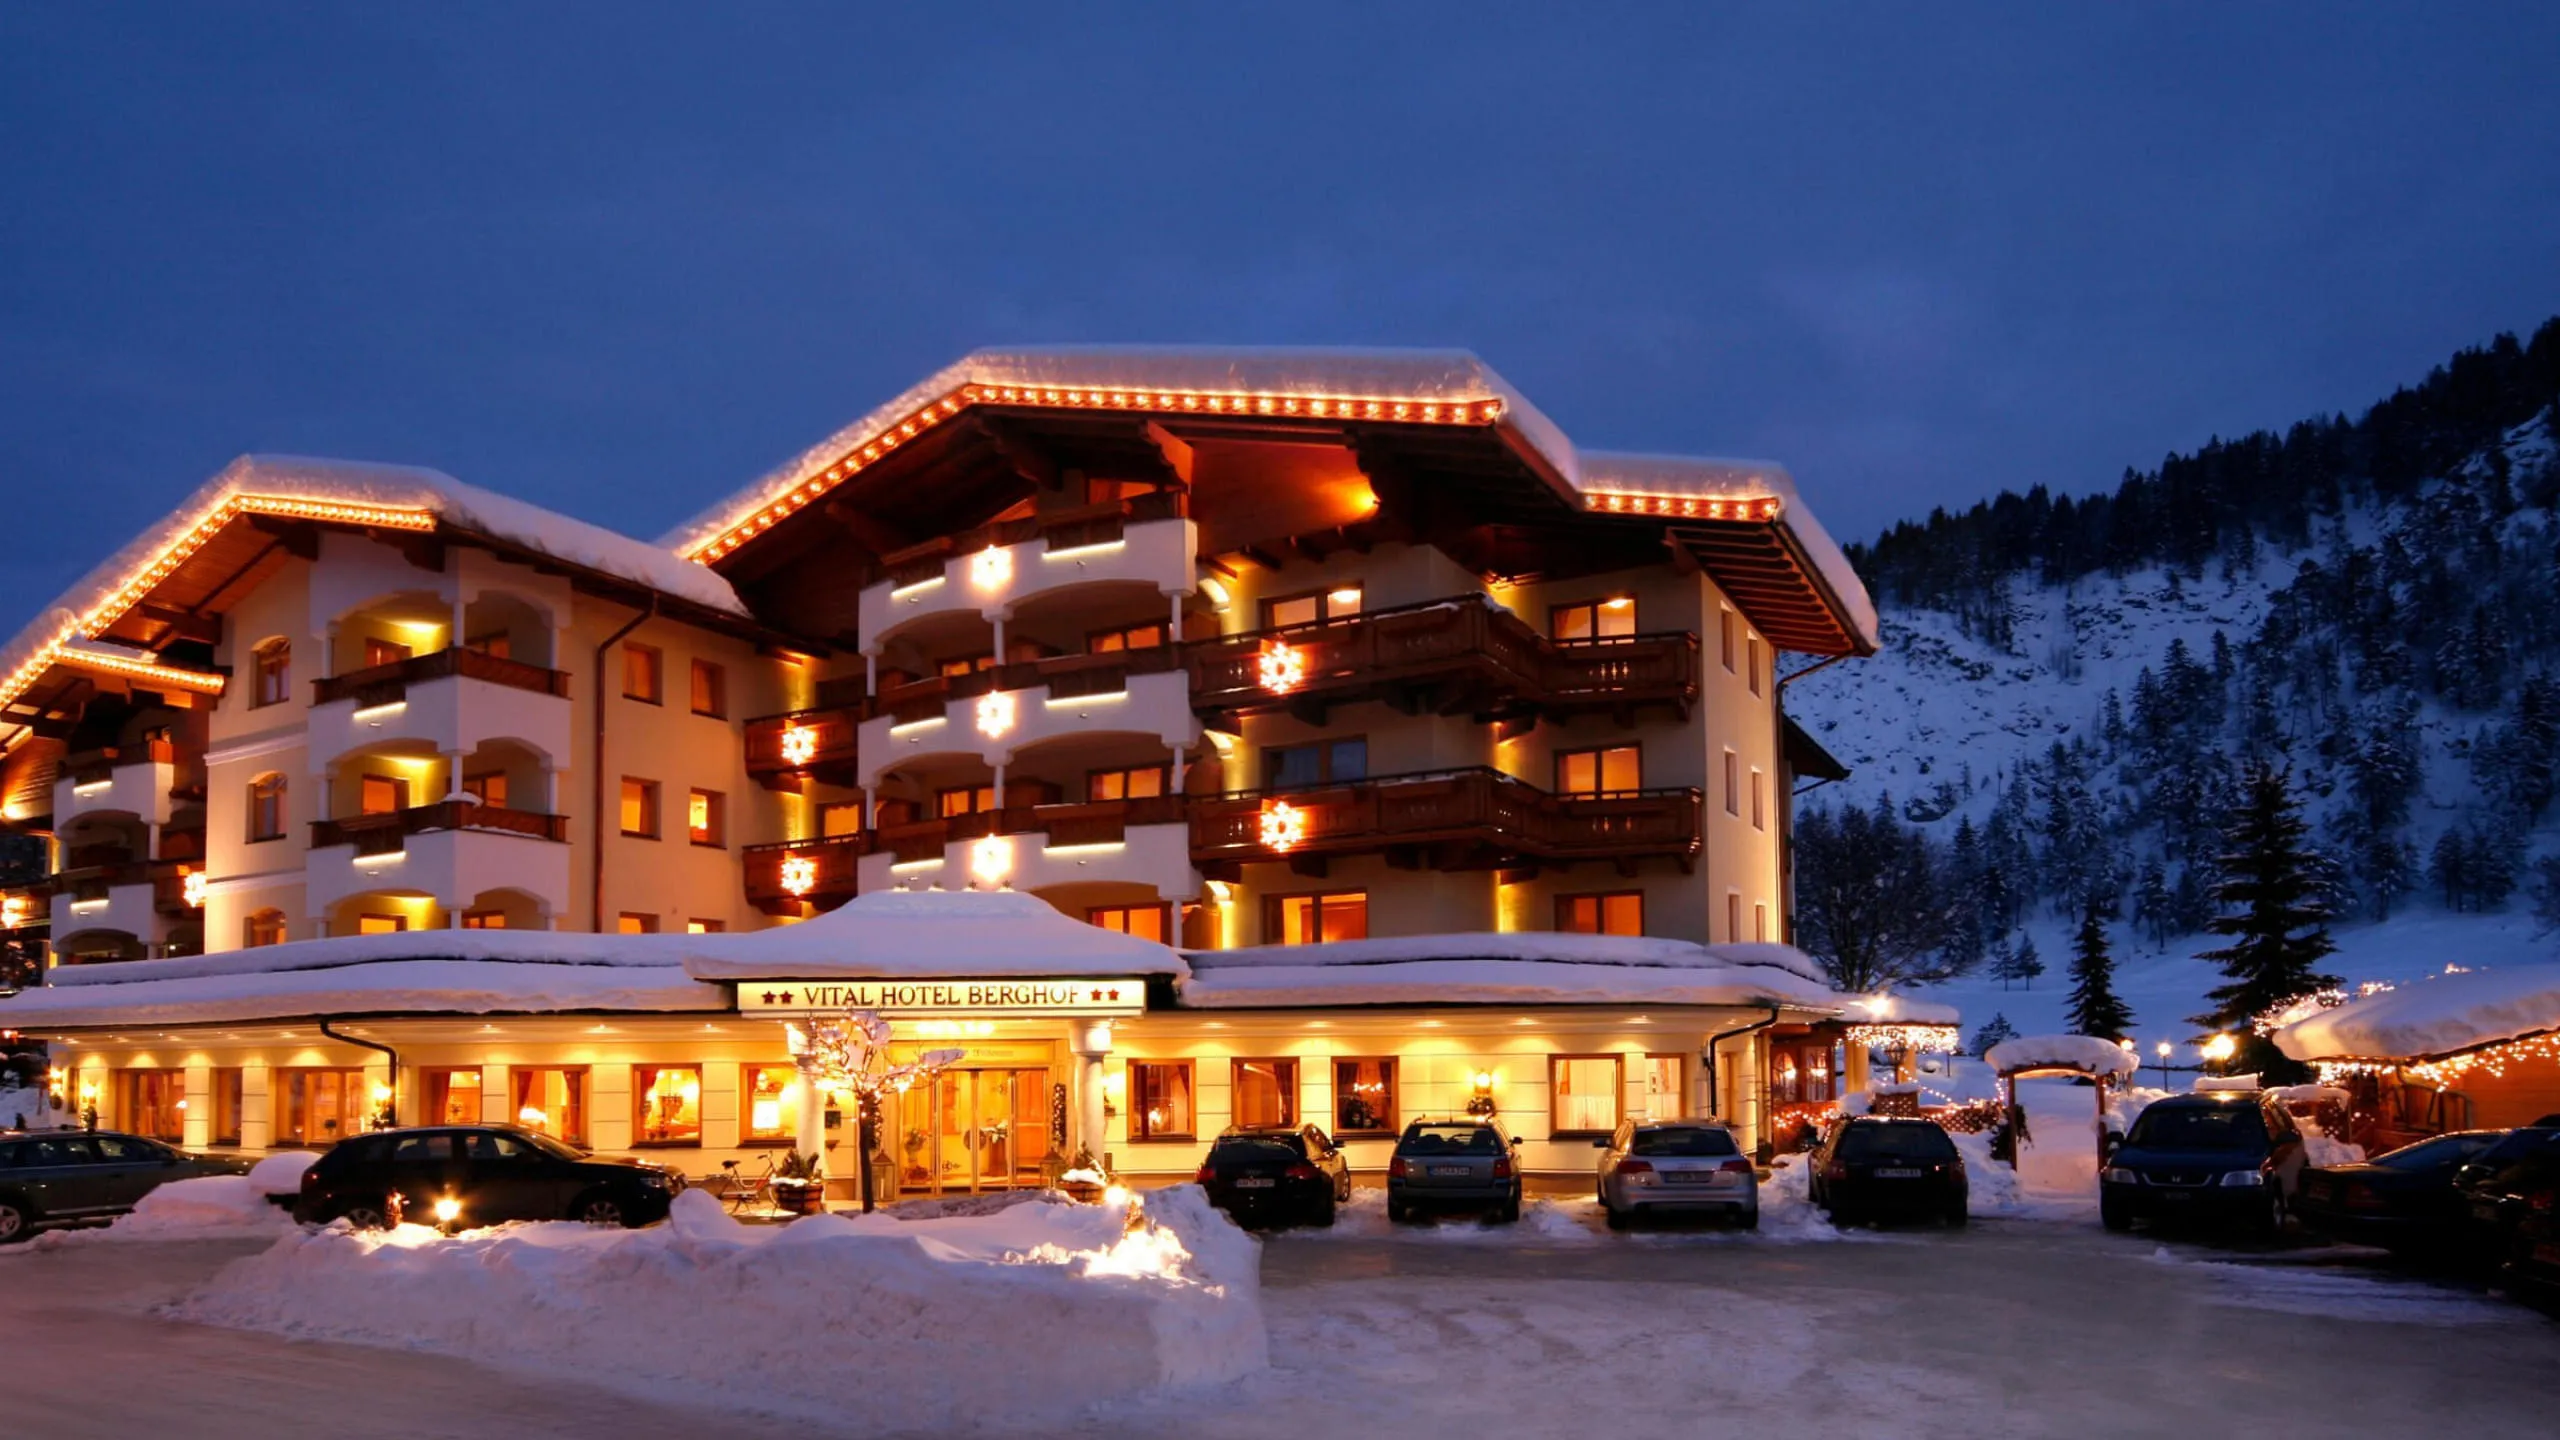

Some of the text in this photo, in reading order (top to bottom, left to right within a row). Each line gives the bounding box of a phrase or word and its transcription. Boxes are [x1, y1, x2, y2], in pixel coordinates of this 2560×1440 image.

[803, 984, 1079, 1006] VITAL HOTEL BERGHOF
